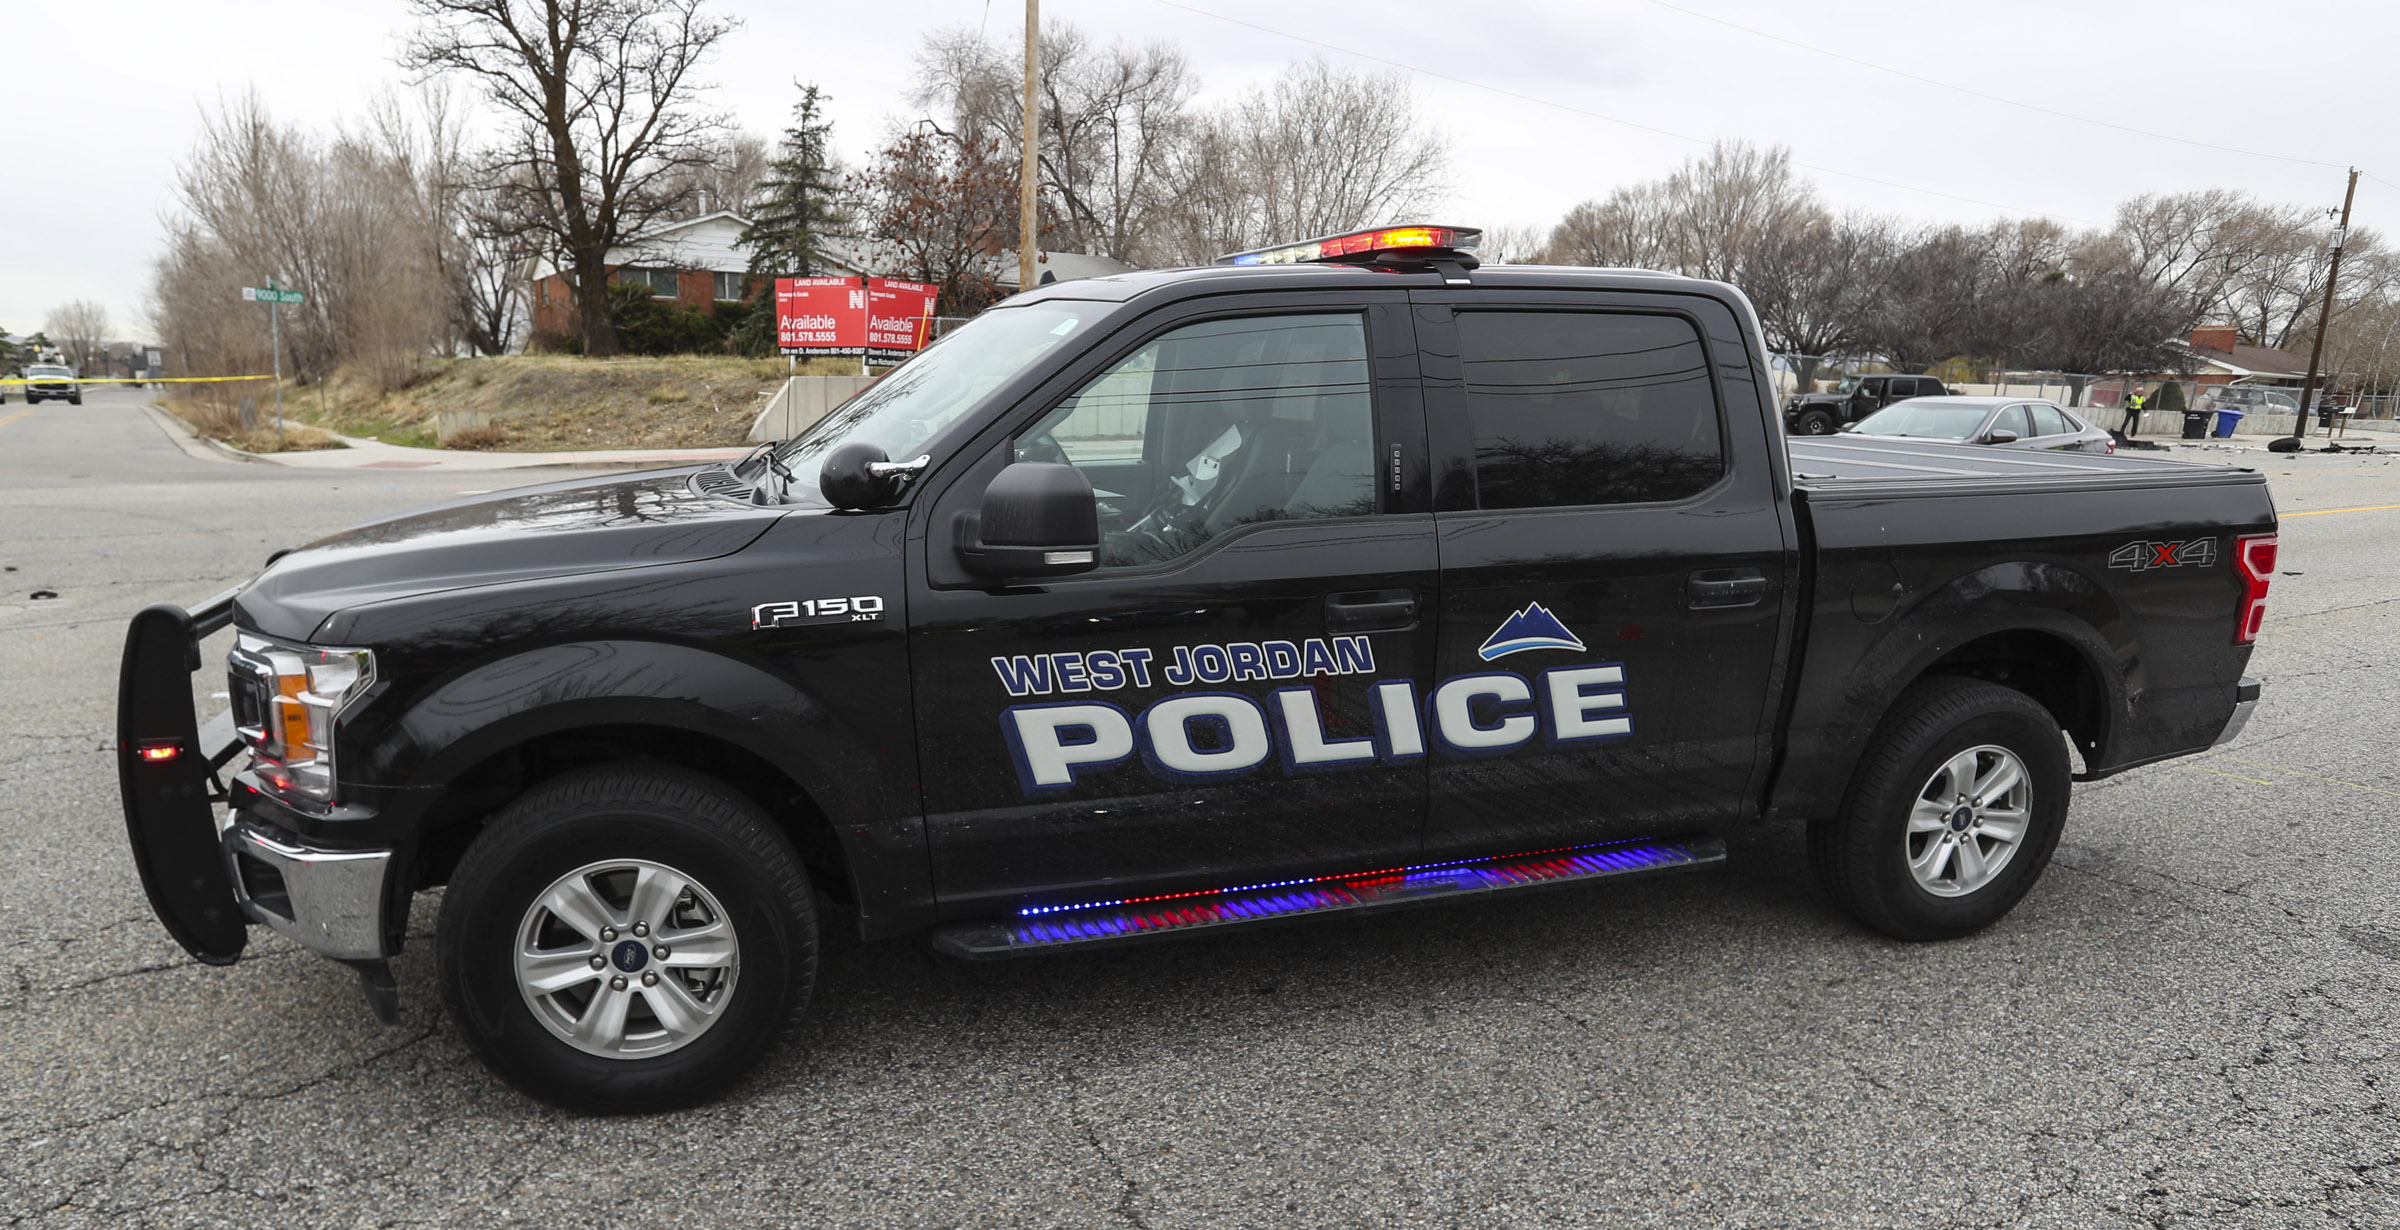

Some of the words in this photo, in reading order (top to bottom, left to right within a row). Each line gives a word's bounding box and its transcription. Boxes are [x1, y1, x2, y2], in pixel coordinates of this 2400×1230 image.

[812, 278, 846, 286] AVAILABLE
[898, 282, 924, 292] AVAILABLE
[849, 290, 864, 309] N
[780, 314, 836, 330] Available
[869, 314, 914, 333] Available
[780, 331, 837, 343] 801.578.5555
[869, 331, 913, 345] 801.578.5555
[851, 613, 879, 622] XLT
[991, 648, 1153, 696] WEST
[1165, 636, 1375, 685] JORDAN
[1000, 661, 1635, 797] POLICE
